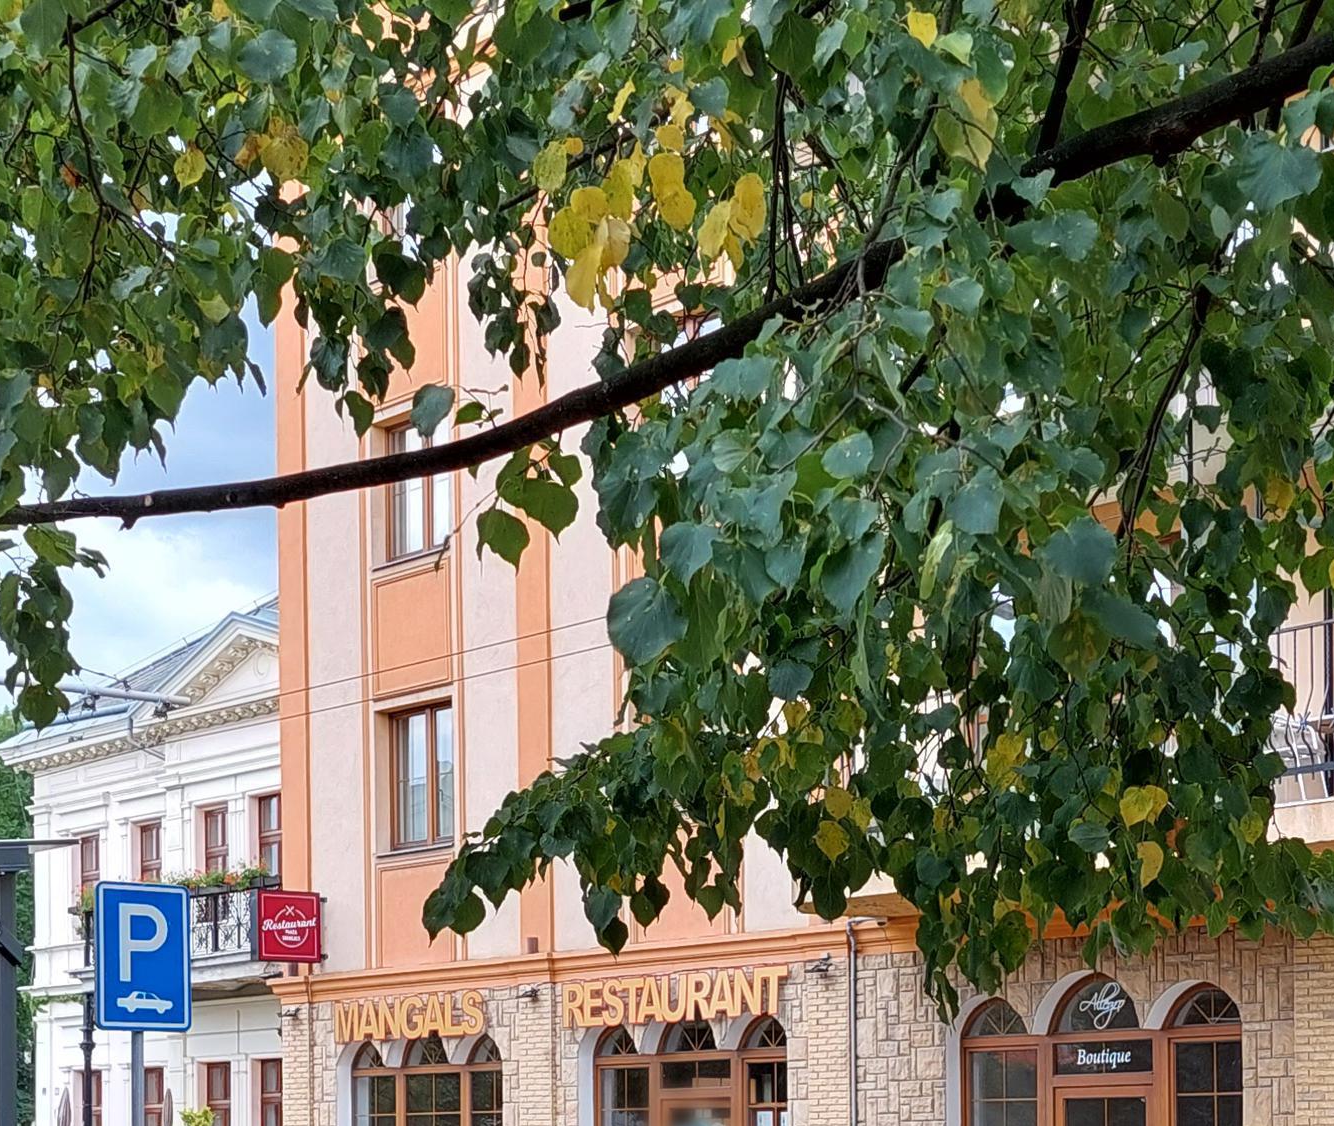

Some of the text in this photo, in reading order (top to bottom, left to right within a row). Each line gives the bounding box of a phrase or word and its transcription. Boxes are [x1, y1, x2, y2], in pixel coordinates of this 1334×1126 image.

[119, 902, 168, 982] P
[261, 917, 317, 931] Restaurant
[334, 964, 789, 1044] MANGALS RESTAURANT
[1076, 1048, 1132, 1070] Boutique
